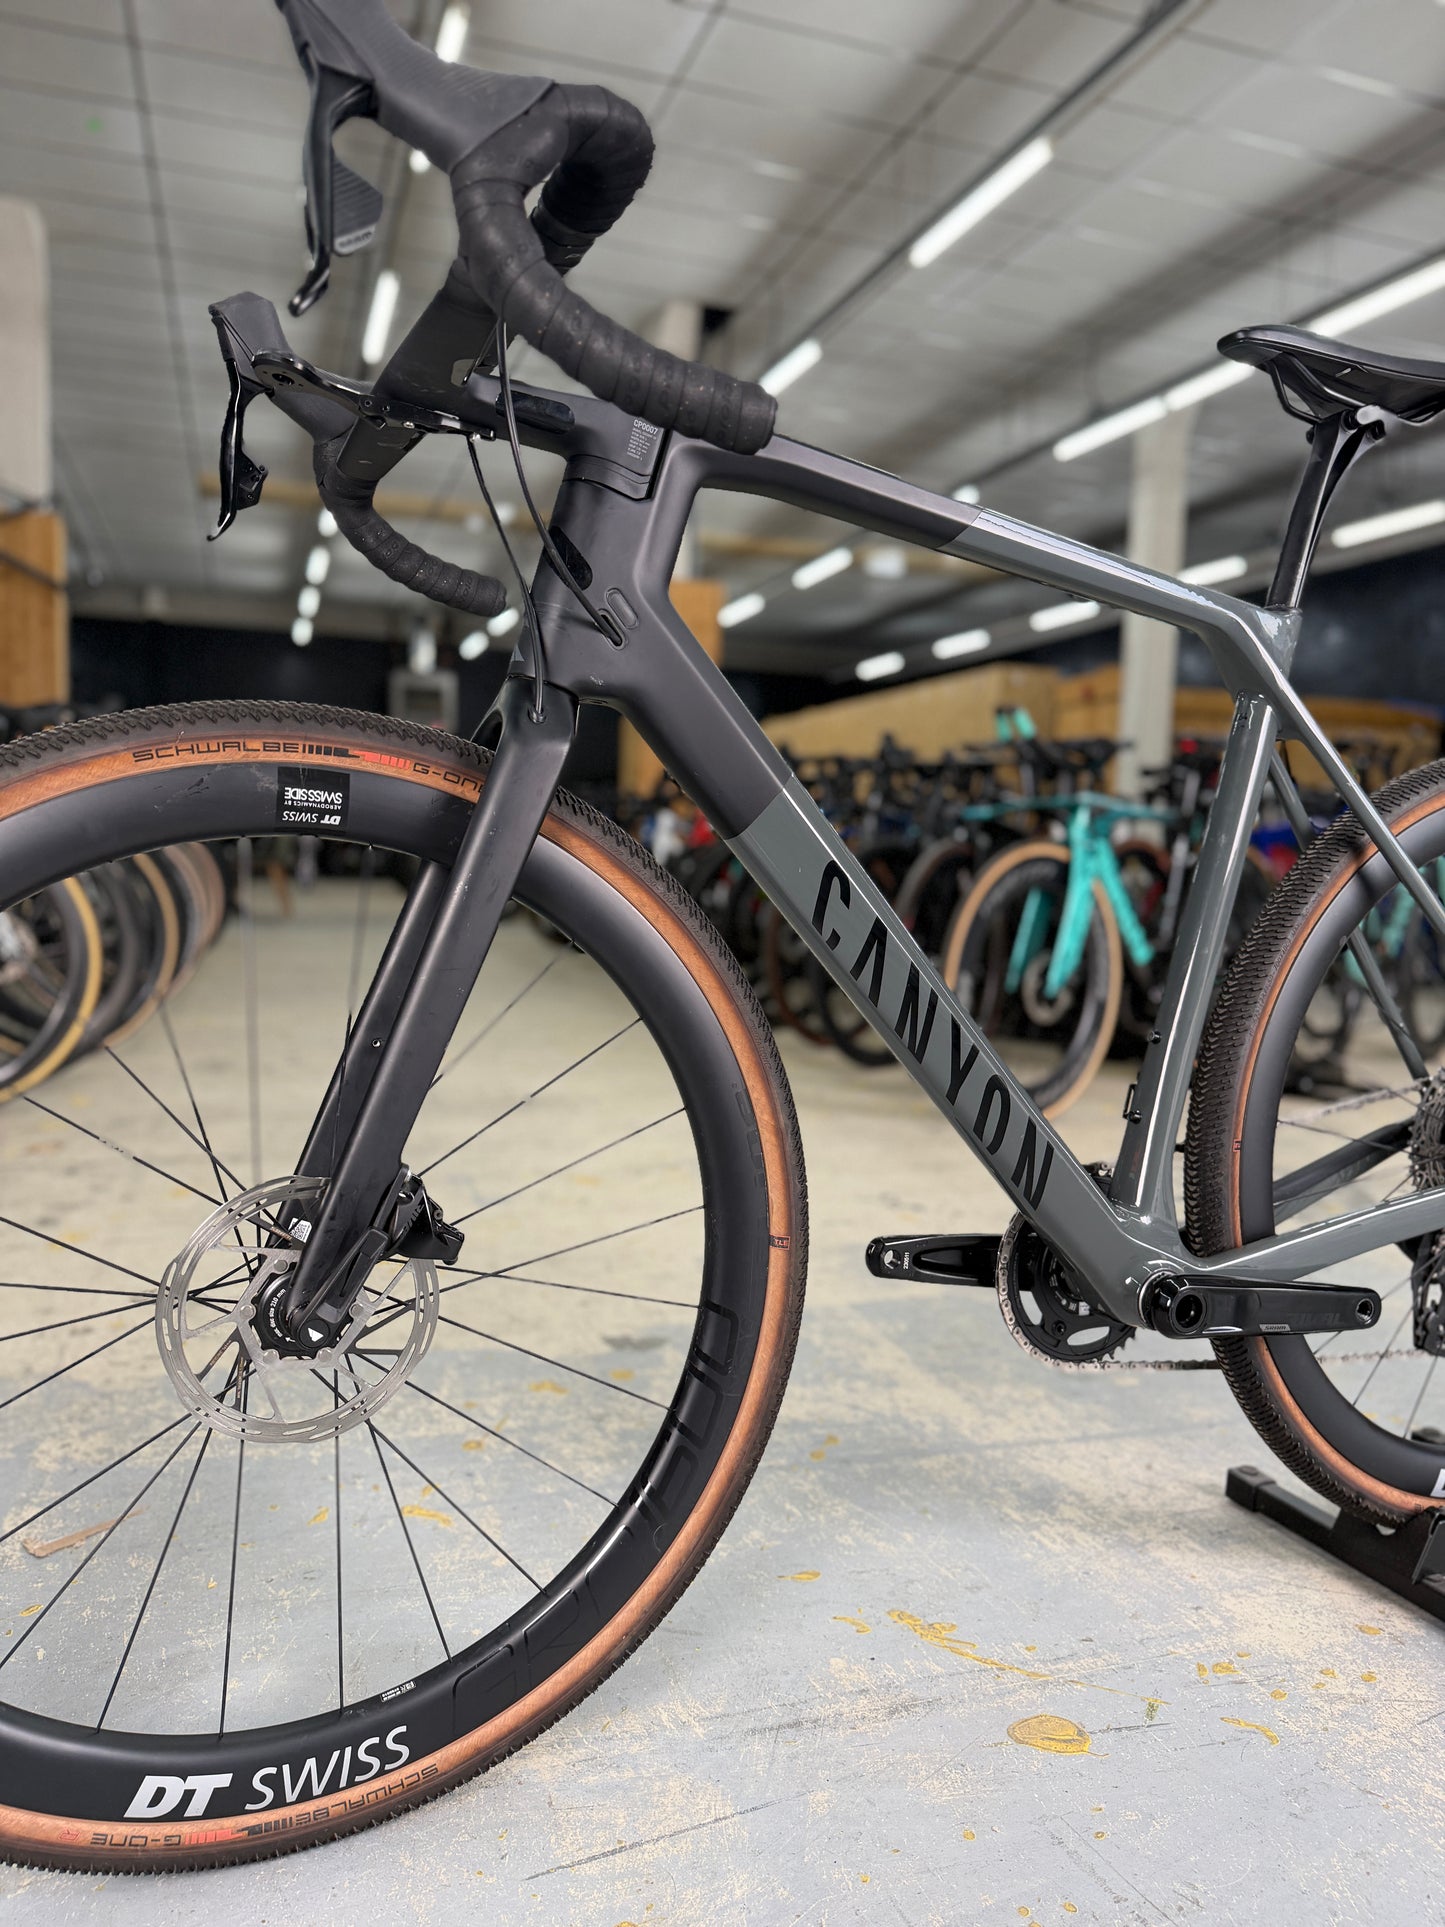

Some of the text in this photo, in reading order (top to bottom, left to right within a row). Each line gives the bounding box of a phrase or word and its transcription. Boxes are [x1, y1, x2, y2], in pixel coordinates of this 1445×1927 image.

[633, 419, 658, 435] CP0007
[132, 741, 299, 763] SCHWALBE
[413, 763, 485, 793] G-ON
[294, 801, 342, 810] AERODYNAMICS
[282, 811, 341, 825] DT SWISS
[812, 860, 1054, 1211] CANYON
[124, 1725, 410, 1819] DT SWISS
[295, 1764, 438, 1826] SCHWALBE
[90, 1833, 181, 1847] G-ONE
